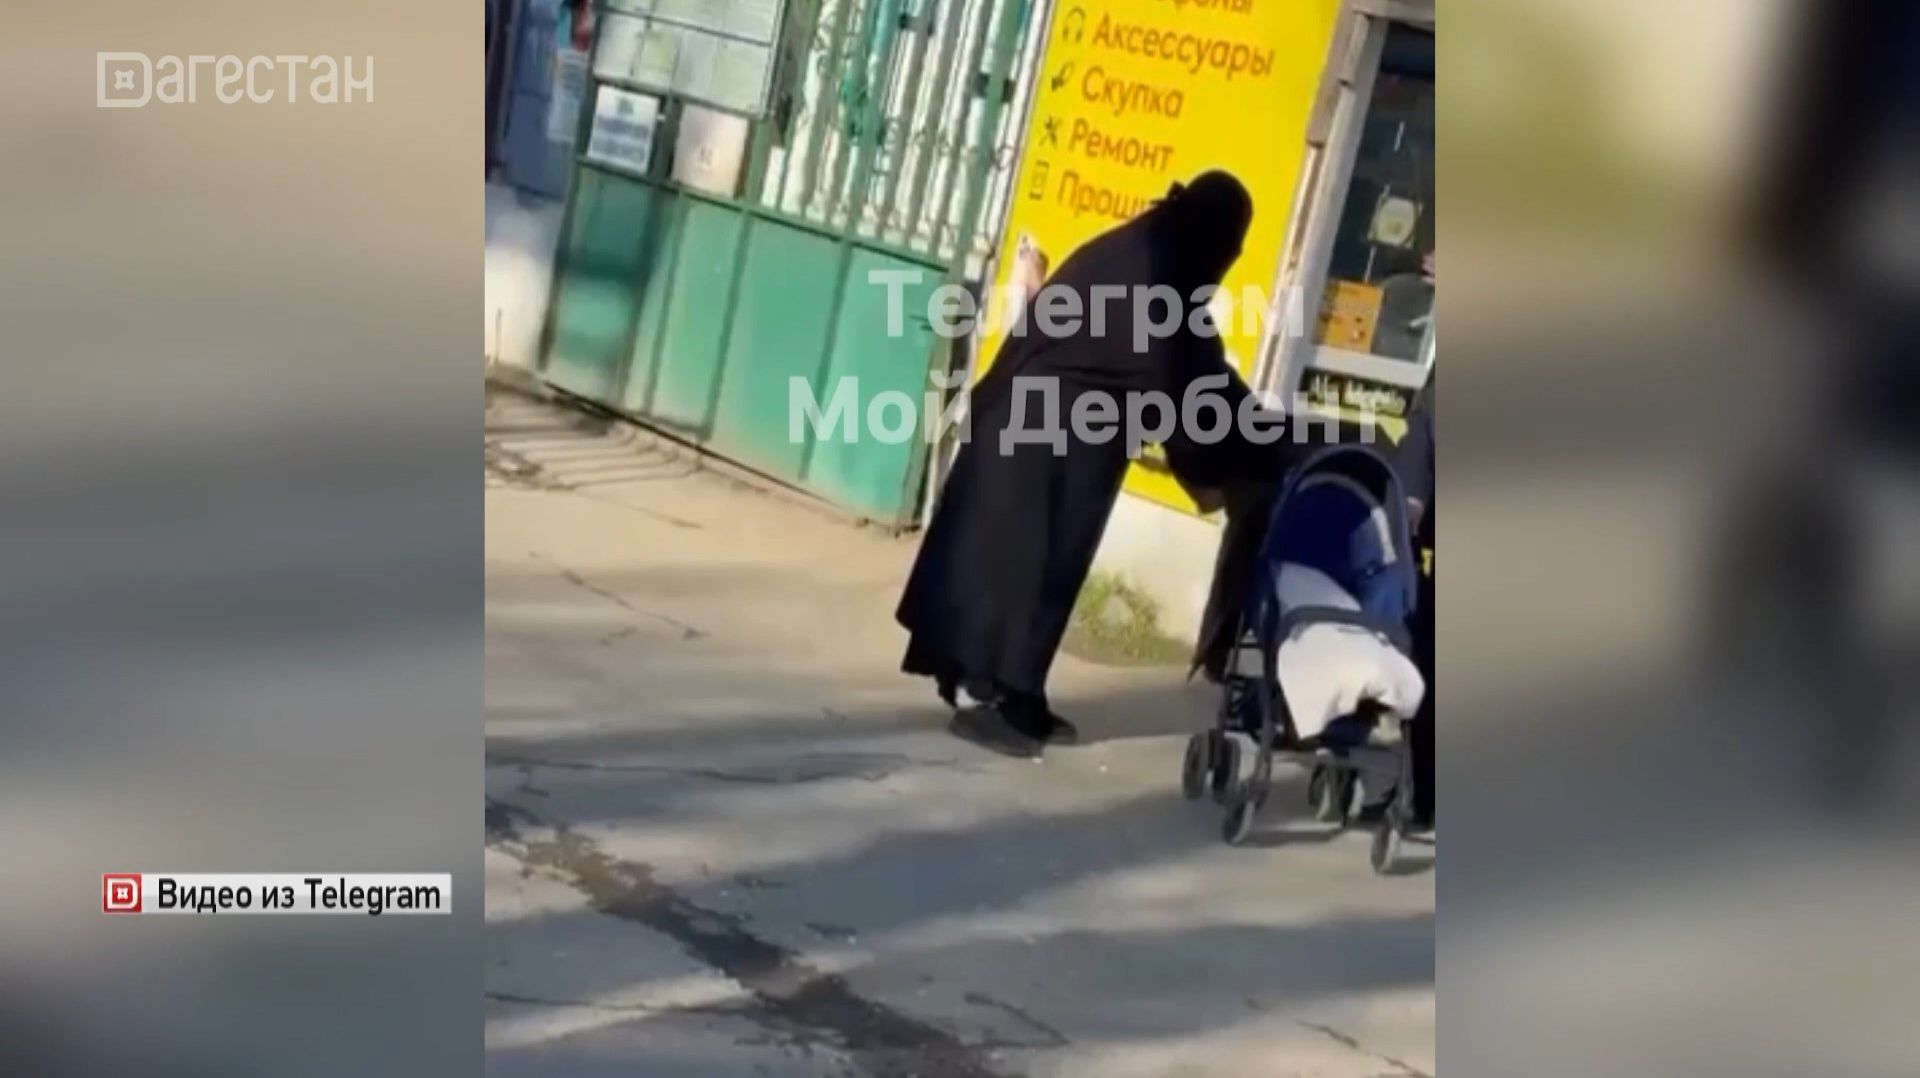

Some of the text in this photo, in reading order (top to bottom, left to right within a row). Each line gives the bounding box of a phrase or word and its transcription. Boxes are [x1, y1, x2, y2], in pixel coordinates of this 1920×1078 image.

[1092, 11, 1276, 79] Аксессуары
[1081, 65, 1184, 119] Скупка
[1068, 117, 1174, 172] Ремонт
[1057, 169, 1150, 219] Прош
